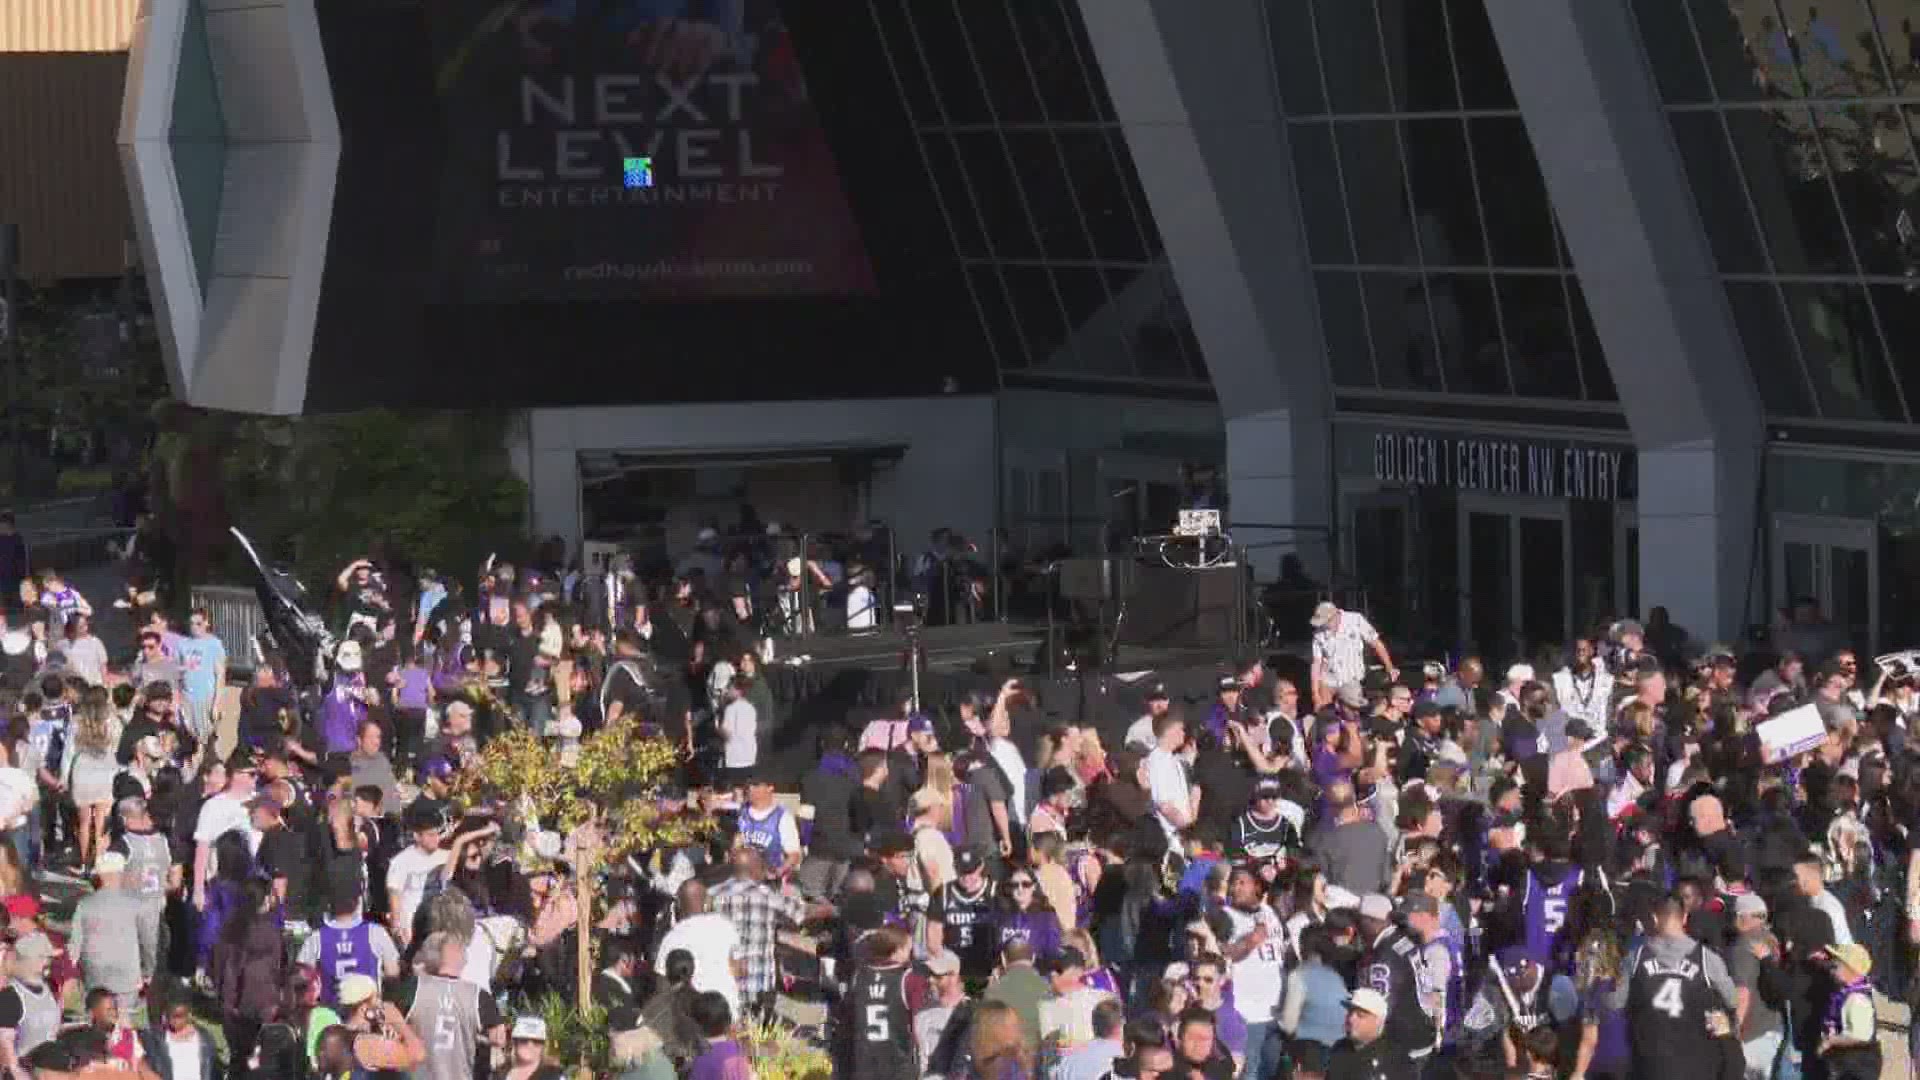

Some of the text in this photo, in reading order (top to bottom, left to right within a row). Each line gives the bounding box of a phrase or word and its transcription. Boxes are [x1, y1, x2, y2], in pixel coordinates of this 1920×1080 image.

[520, 74, 759, 124] NEXT
[497, 128, 785, 180] LEVEL
[499, 183, 778, 207] ENTERTAINMENT
[1375, 433, 1438, 484] GOLDEN
[1457, 440, 1520, 494] CENTER
[1528, 445, 1553, 497] NW
[1564, 448, 1621, 501] ENTRY
[1544, 899, 1568, 932] 5
[1652, 978, 1685, 1019] 4
[434, 1015, 456, 1050] 5
[866, 1005, 890, 1042] 5
